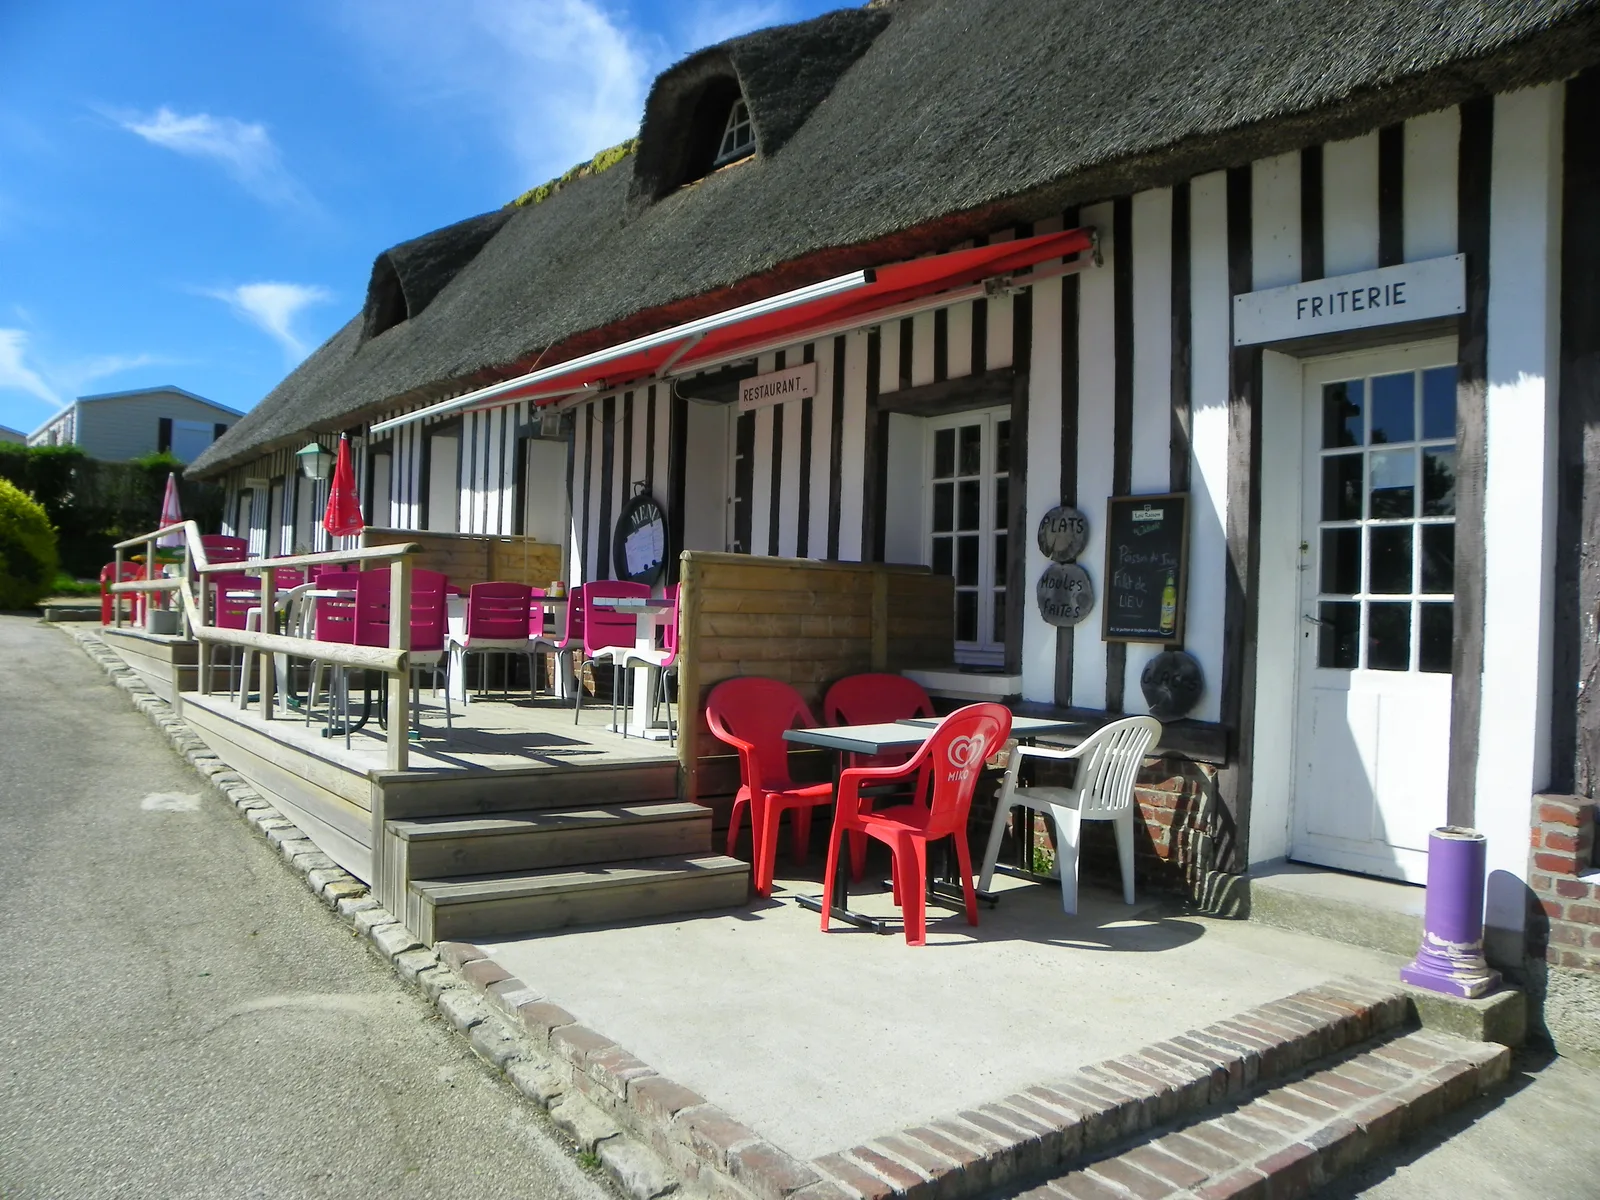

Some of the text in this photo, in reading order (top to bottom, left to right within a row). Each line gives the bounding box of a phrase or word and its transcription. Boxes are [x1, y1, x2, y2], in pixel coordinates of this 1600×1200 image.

[1296, 281, 1407, 320] FRITERIE
[631, 503, 660, 526] MENU
[1041, 515, 1084, 534] PLATS
[947, 769, 969, 781] MIKO
